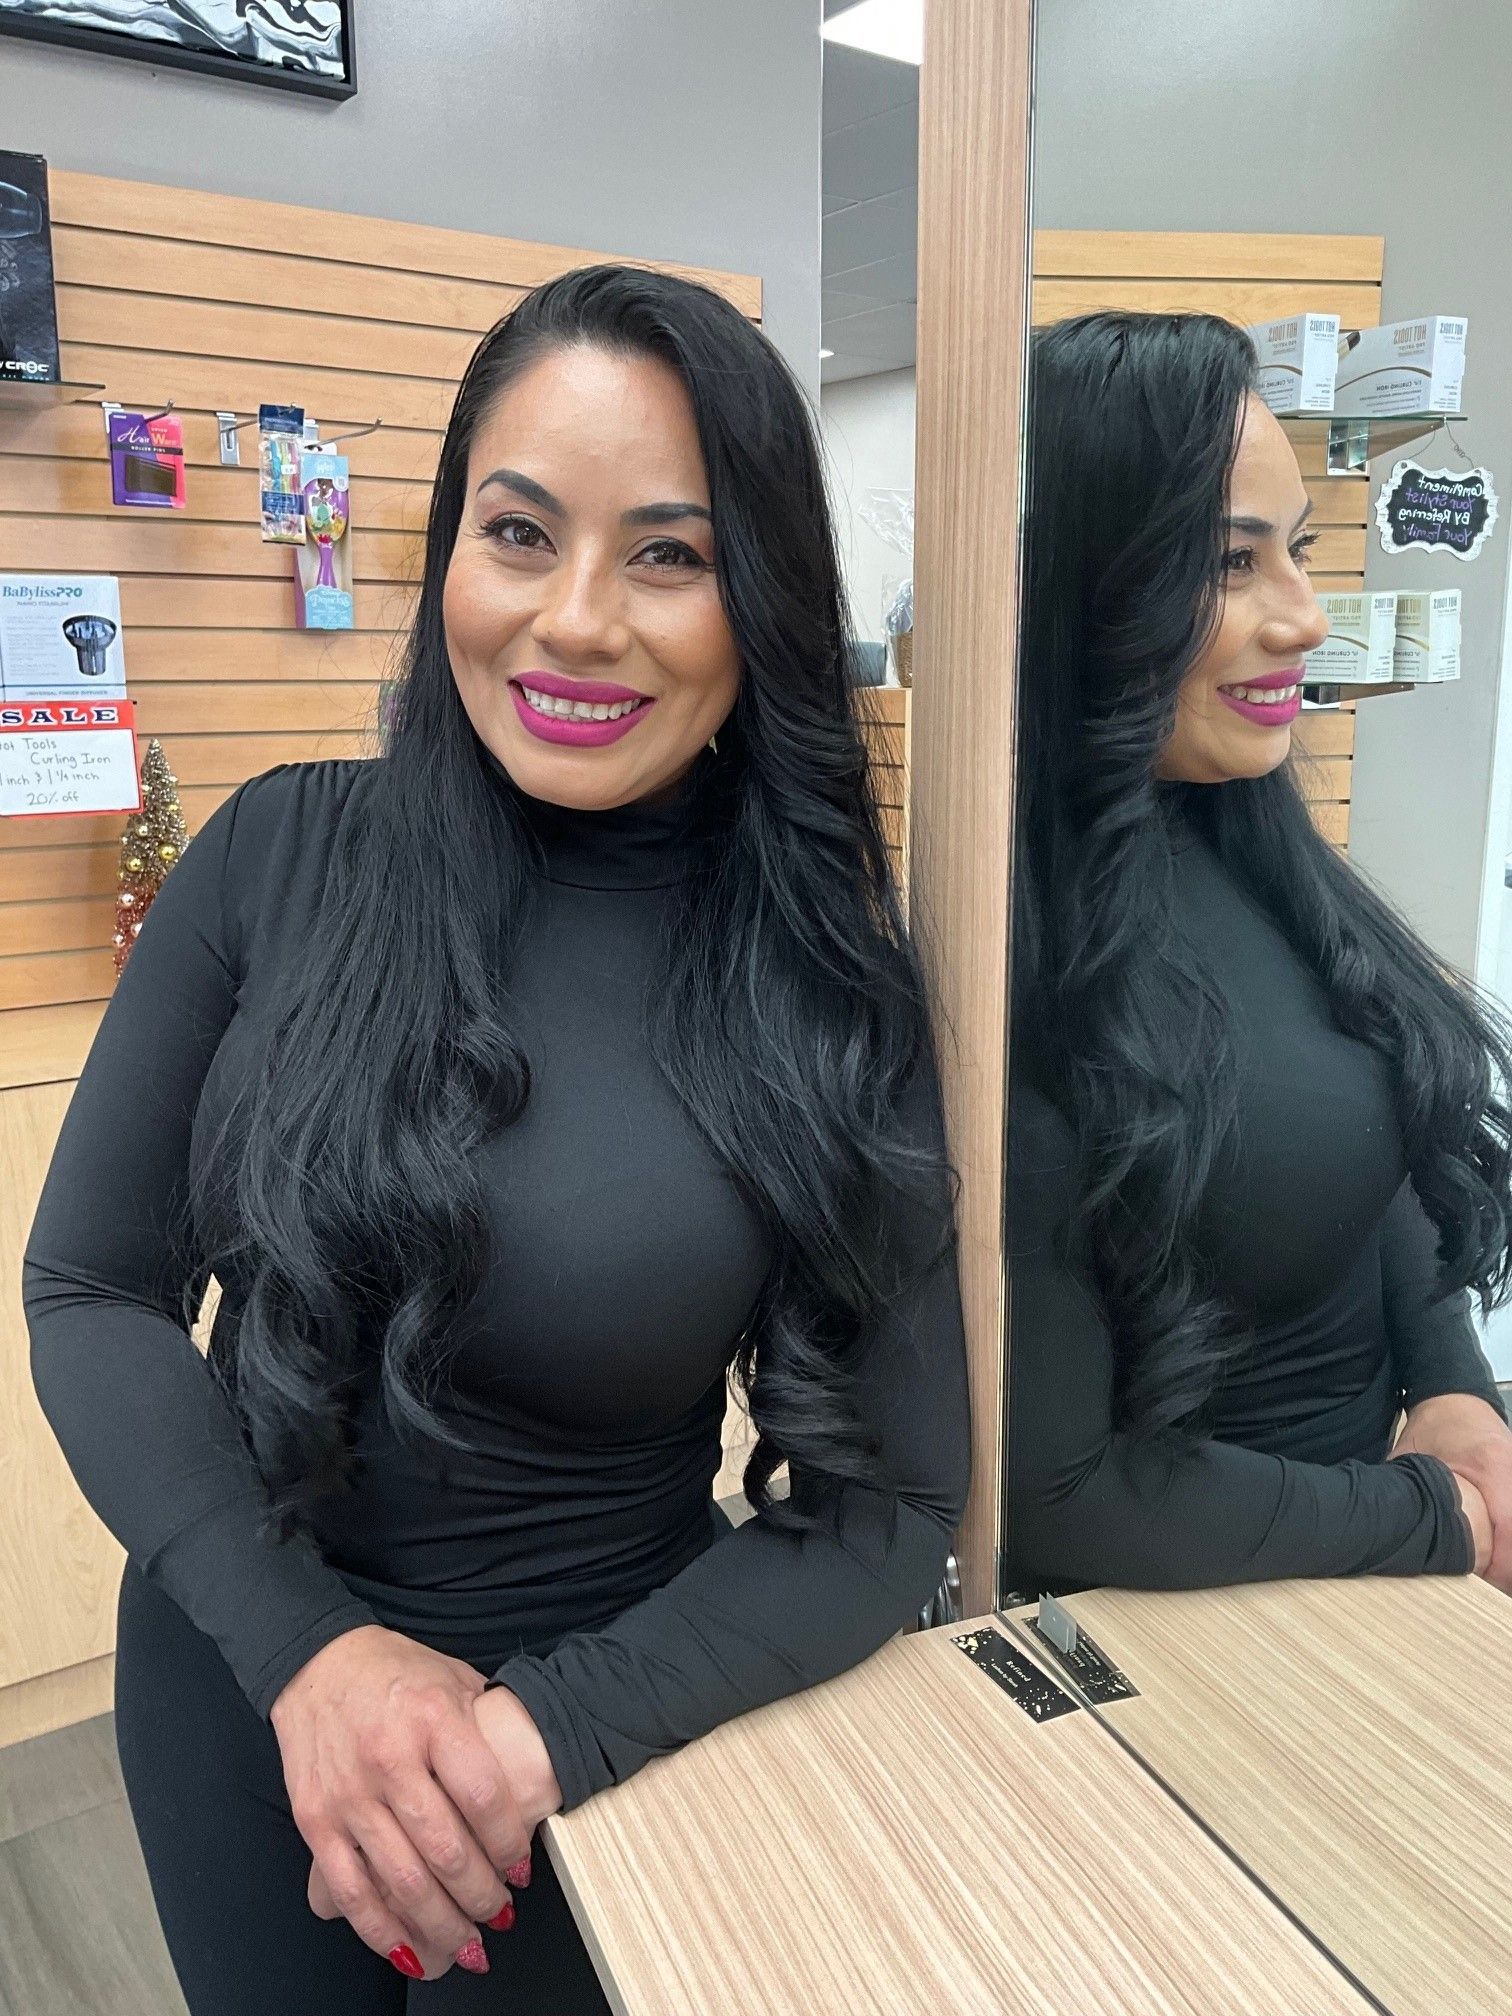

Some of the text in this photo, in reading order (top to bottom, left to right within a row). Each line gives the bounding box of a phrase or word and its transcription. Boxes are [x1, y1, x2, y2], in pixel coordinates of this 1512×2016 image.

[117, 424, 150, 443] Hair
[2, 586, 83, 600] BaBylissPRO
[2, 709, 116, 725] SALE
[22, 738, 57, 750] Tools
[30, 752, 111, 769] Curling Iron
[7, 774, 29, 785] inch
[73, 772, 100, 781] inch
[62, 791, 80, 801] off
